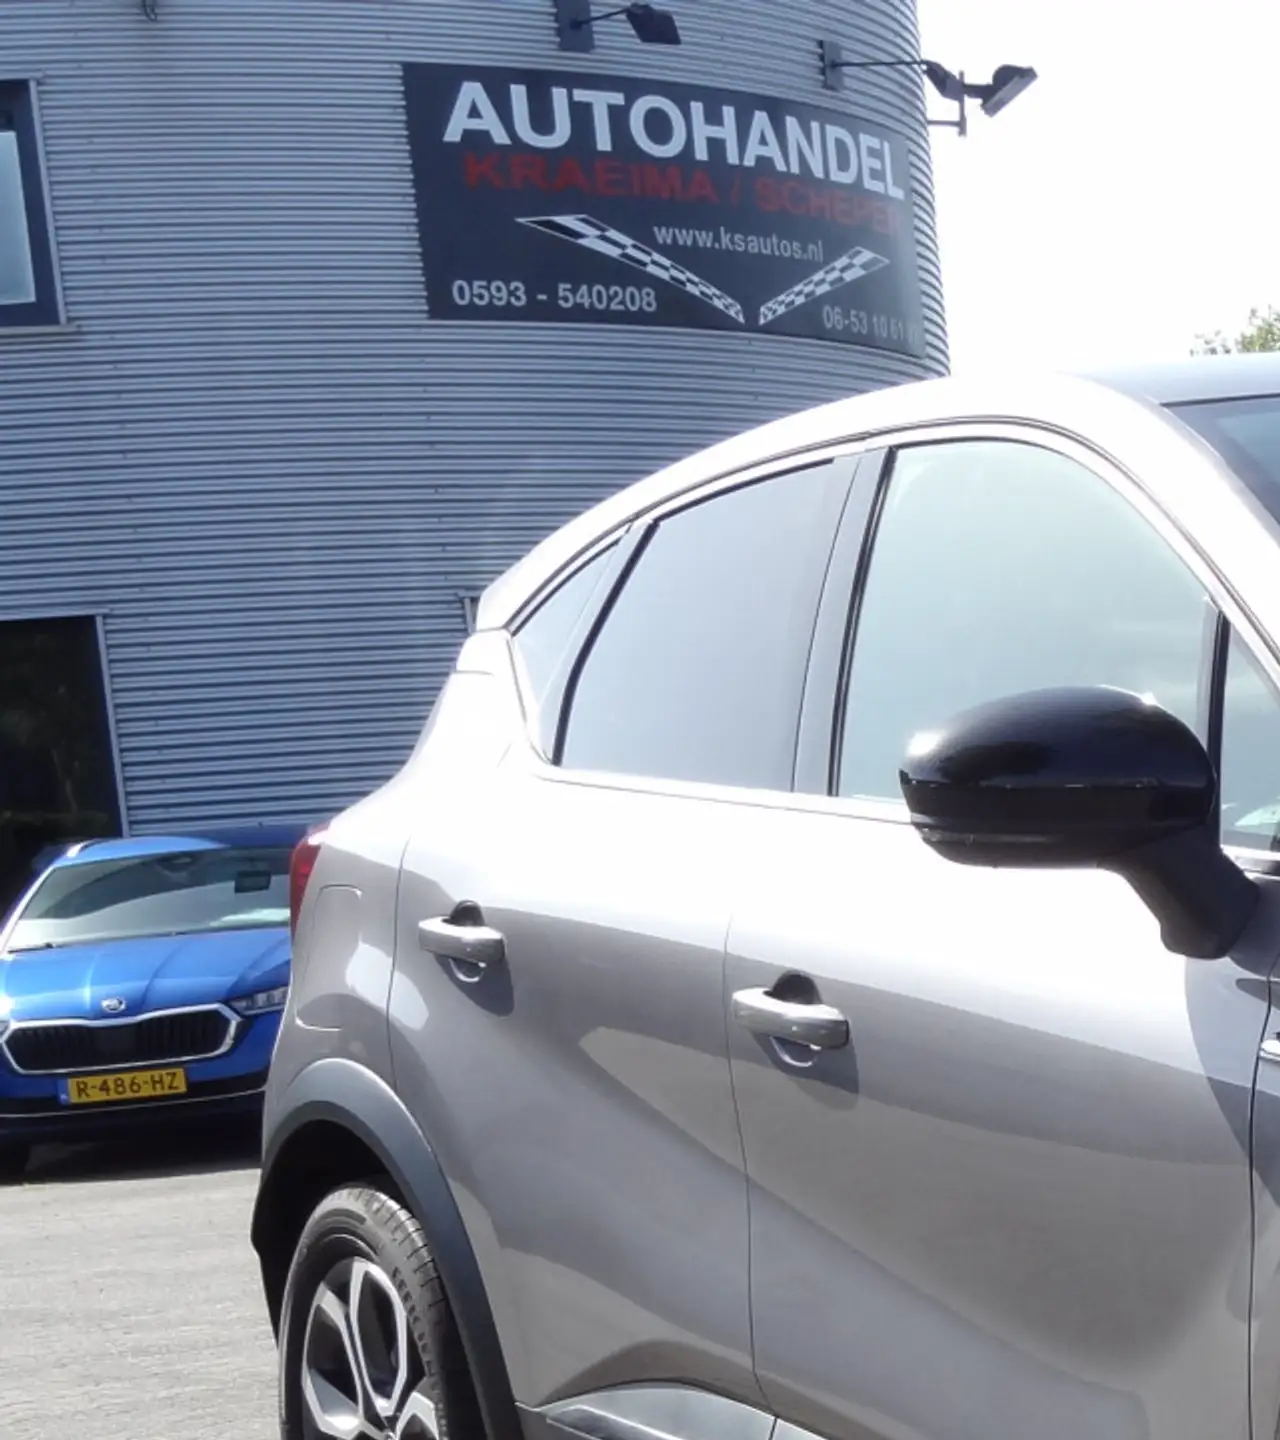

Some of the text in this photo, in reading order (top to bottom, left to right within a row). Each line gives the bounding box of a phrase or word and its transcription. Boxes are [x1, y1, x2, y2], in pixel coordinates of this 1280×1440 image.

[443, 81, 905, 200] AUTOHANDEL
[464, 150, 719, 203] KRAEIMA
[653, 224, 824, 264] www.ksautos.nl
[452, 280, 527, 307] 0593
[557, 282, 657, 312] 540208
[823, 304, 868, 335] 06-53
[75, 1072, 181, 1099] R-486-HZ
